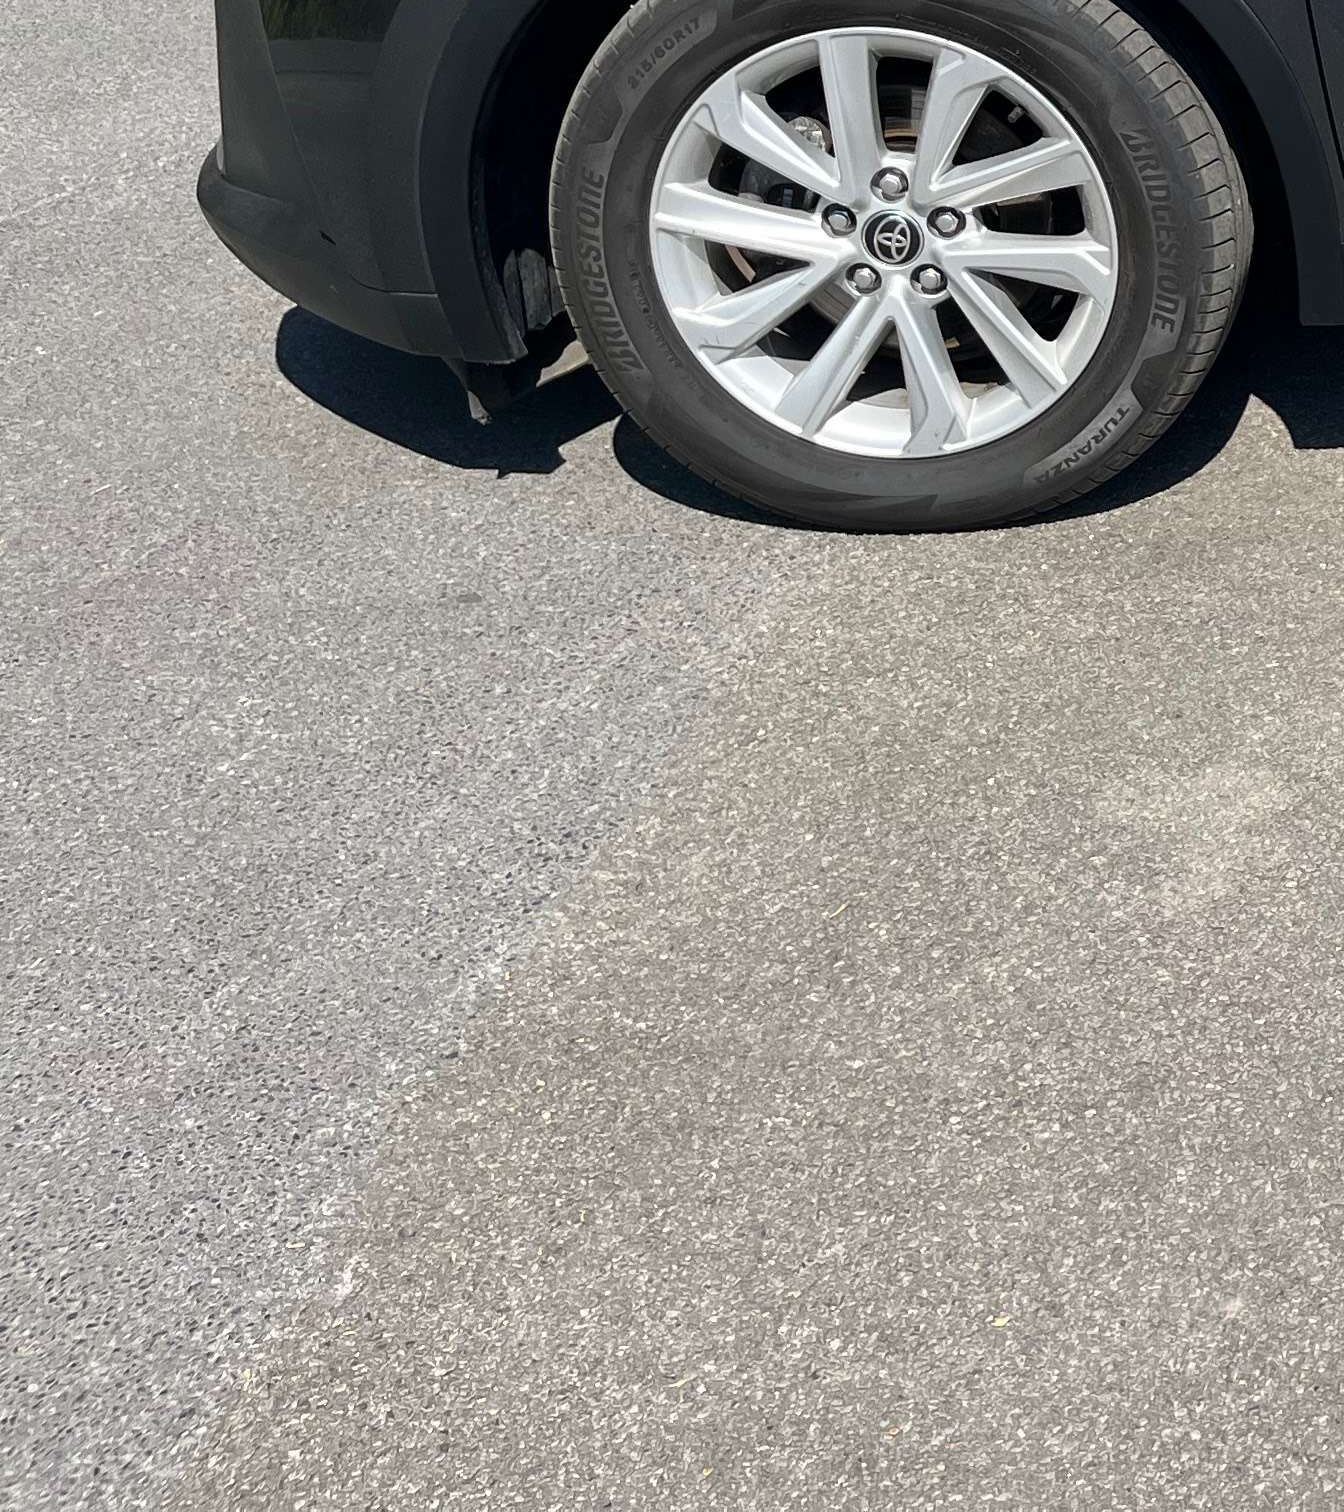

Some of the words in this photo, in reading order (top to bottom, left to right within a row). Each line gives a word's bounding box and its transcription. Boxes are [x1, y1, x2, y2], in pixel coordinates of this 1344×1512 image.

[576, 166, 647, 372] BRIDGESTONE
[1119, 127, 1181, 336] BRIDGESTONE
[1033, 404, 1132, 485] TURANZA
